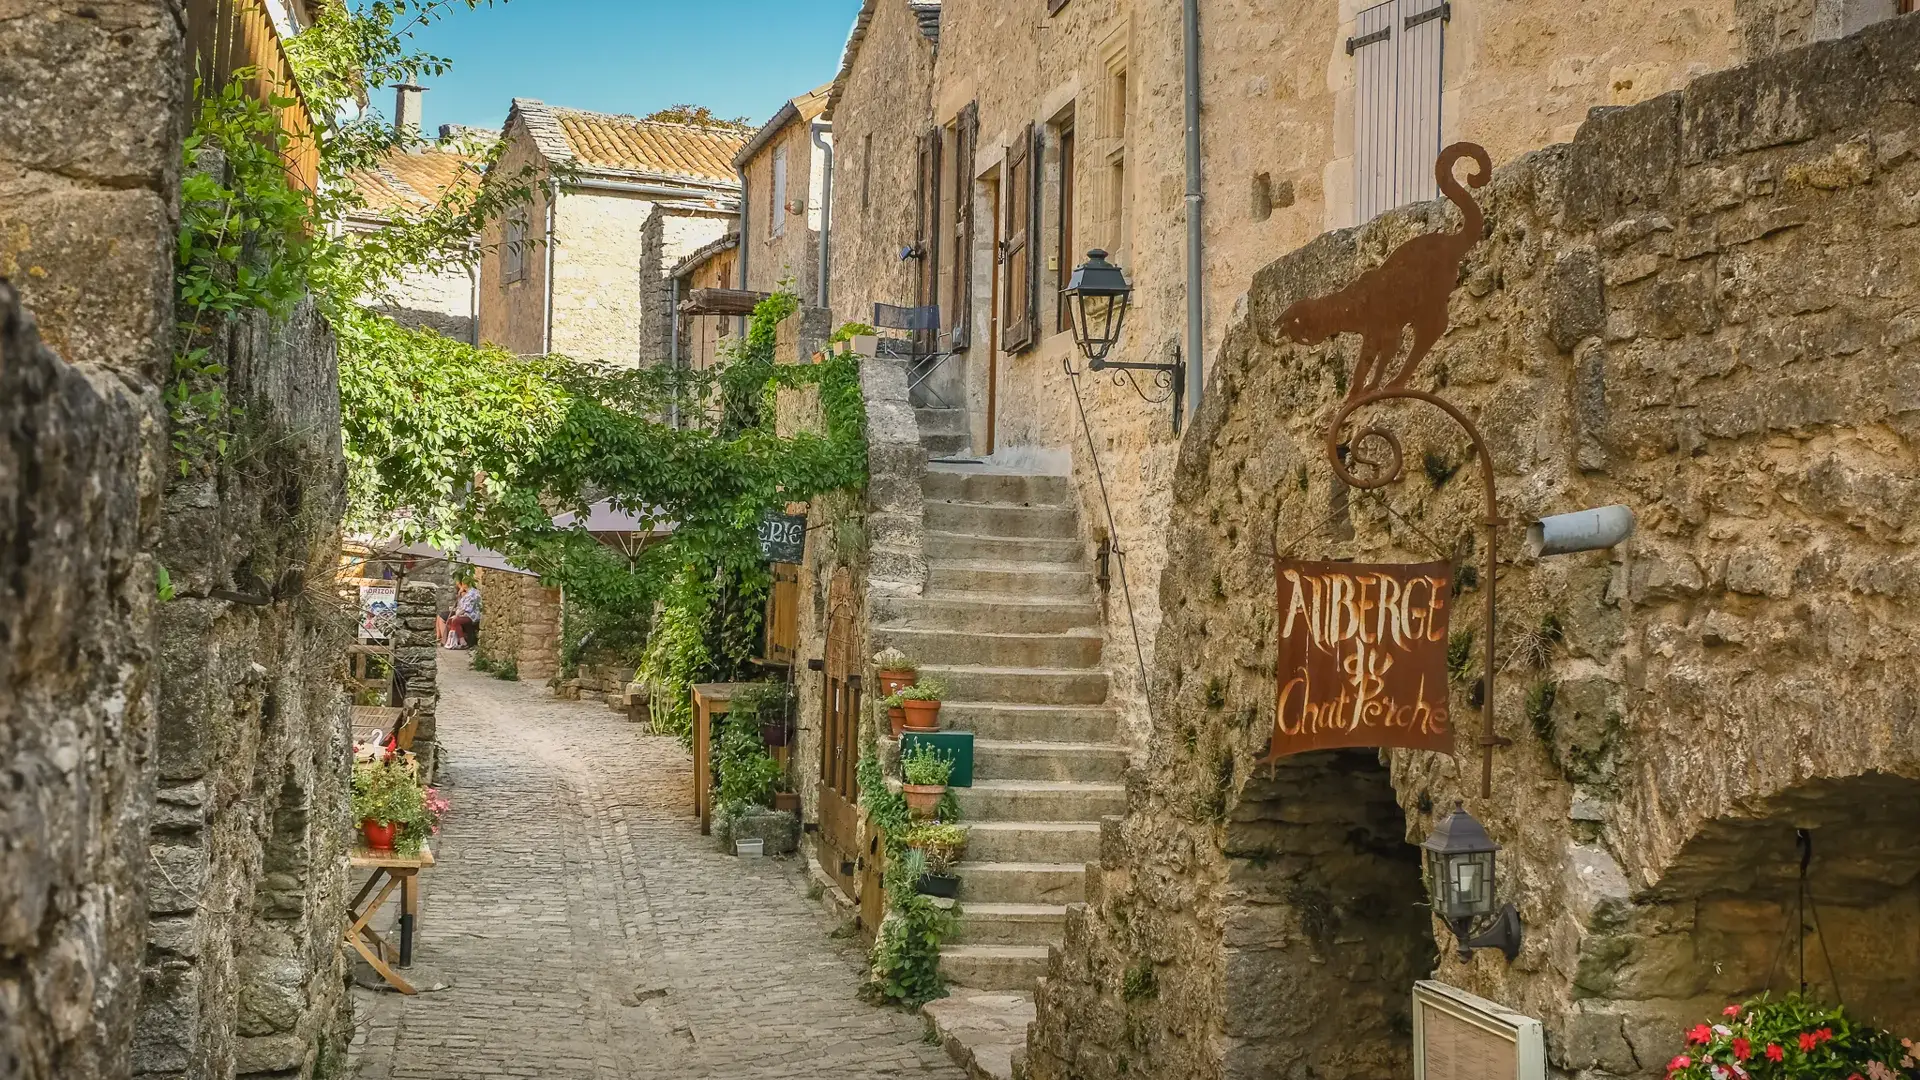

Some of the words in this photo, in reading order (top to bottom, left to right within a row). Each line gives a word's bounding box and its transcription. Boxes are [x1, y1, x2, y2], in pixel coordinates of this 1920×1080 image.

[757, 520, 802, 545] ERIE
[1281, 568, 1448, 655] AUBERGE
[1343, 636, 1394, 686] du
[1278, 666, 1349, 735] Chat
